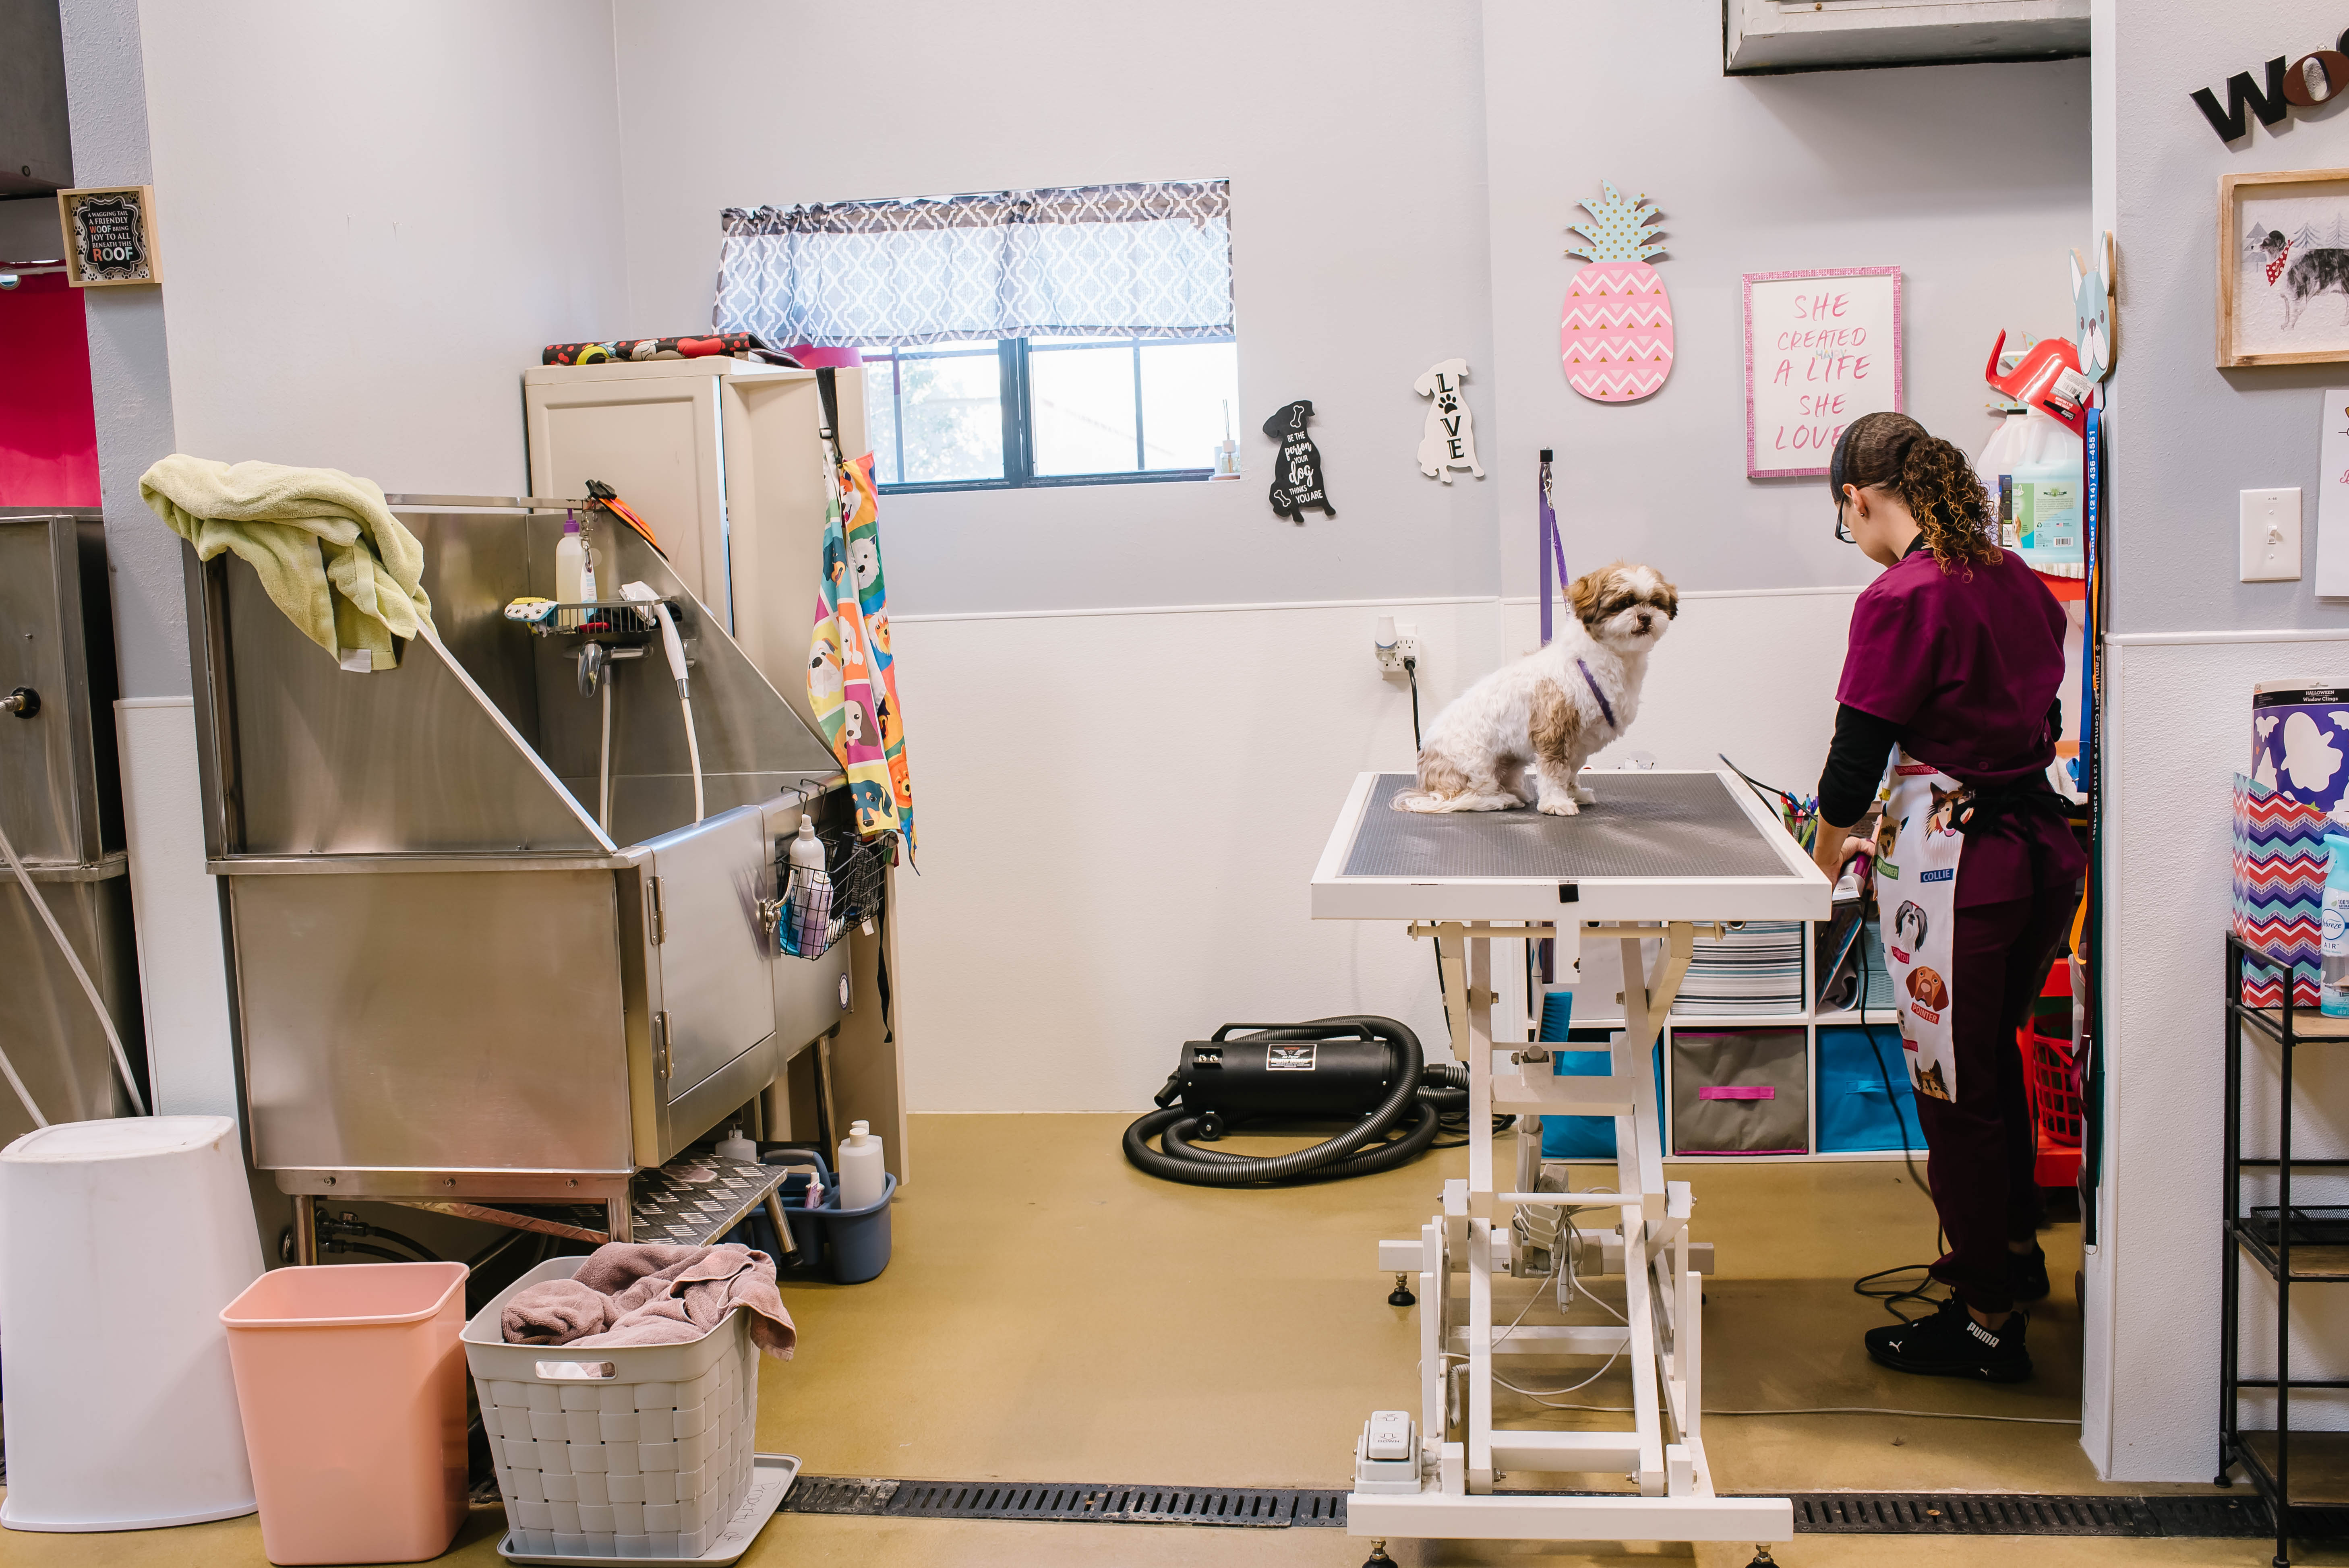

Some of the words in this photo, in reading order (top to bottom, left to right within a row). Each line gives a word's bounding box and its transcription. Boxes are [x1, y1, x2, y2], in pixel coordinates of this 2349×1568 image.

[2189, 26, 2349, 143] WO
[95, 217, 128, 225] FRIENDLY
[89, 225, 111, 233] WOOF
[91, 234, 104, 242] JOY
[93, 247, 133, 261] ROOF
[1794, 291, 1852, 321] SHE
[1778, 327, 1867, 351] CREATED
[1774, 359, 1794, 386] A
[1807, 354, 1872, 383] LIFE
[1799, 393, 1848, 418] SHE
[1287, 434, 1294, 443] BE
[1294, 431, 1306, 440] THE
[1285, 442, 1312, 461] person
[1294, 455, 1308, 464] YOUR
[1289, 461, 1314, 487] dog
[1289, 485, 1307, 495] THINKS
[1295, 494, 1310, 504] YOU
[1311, 490, 1323, 500] ARE
[1882, 864, 1898, 877] TERRIER
[1923, 869, 1950, 881] COLLIE
[1900, 953, 1909, 962] TZU
[1912, 1003, 1937, 1023] POINTER
[1966, 1322, 1999, 1348] PUMA
[731, 1481, 780, 1523] Property
[722, 1532, 744, 1541] of
